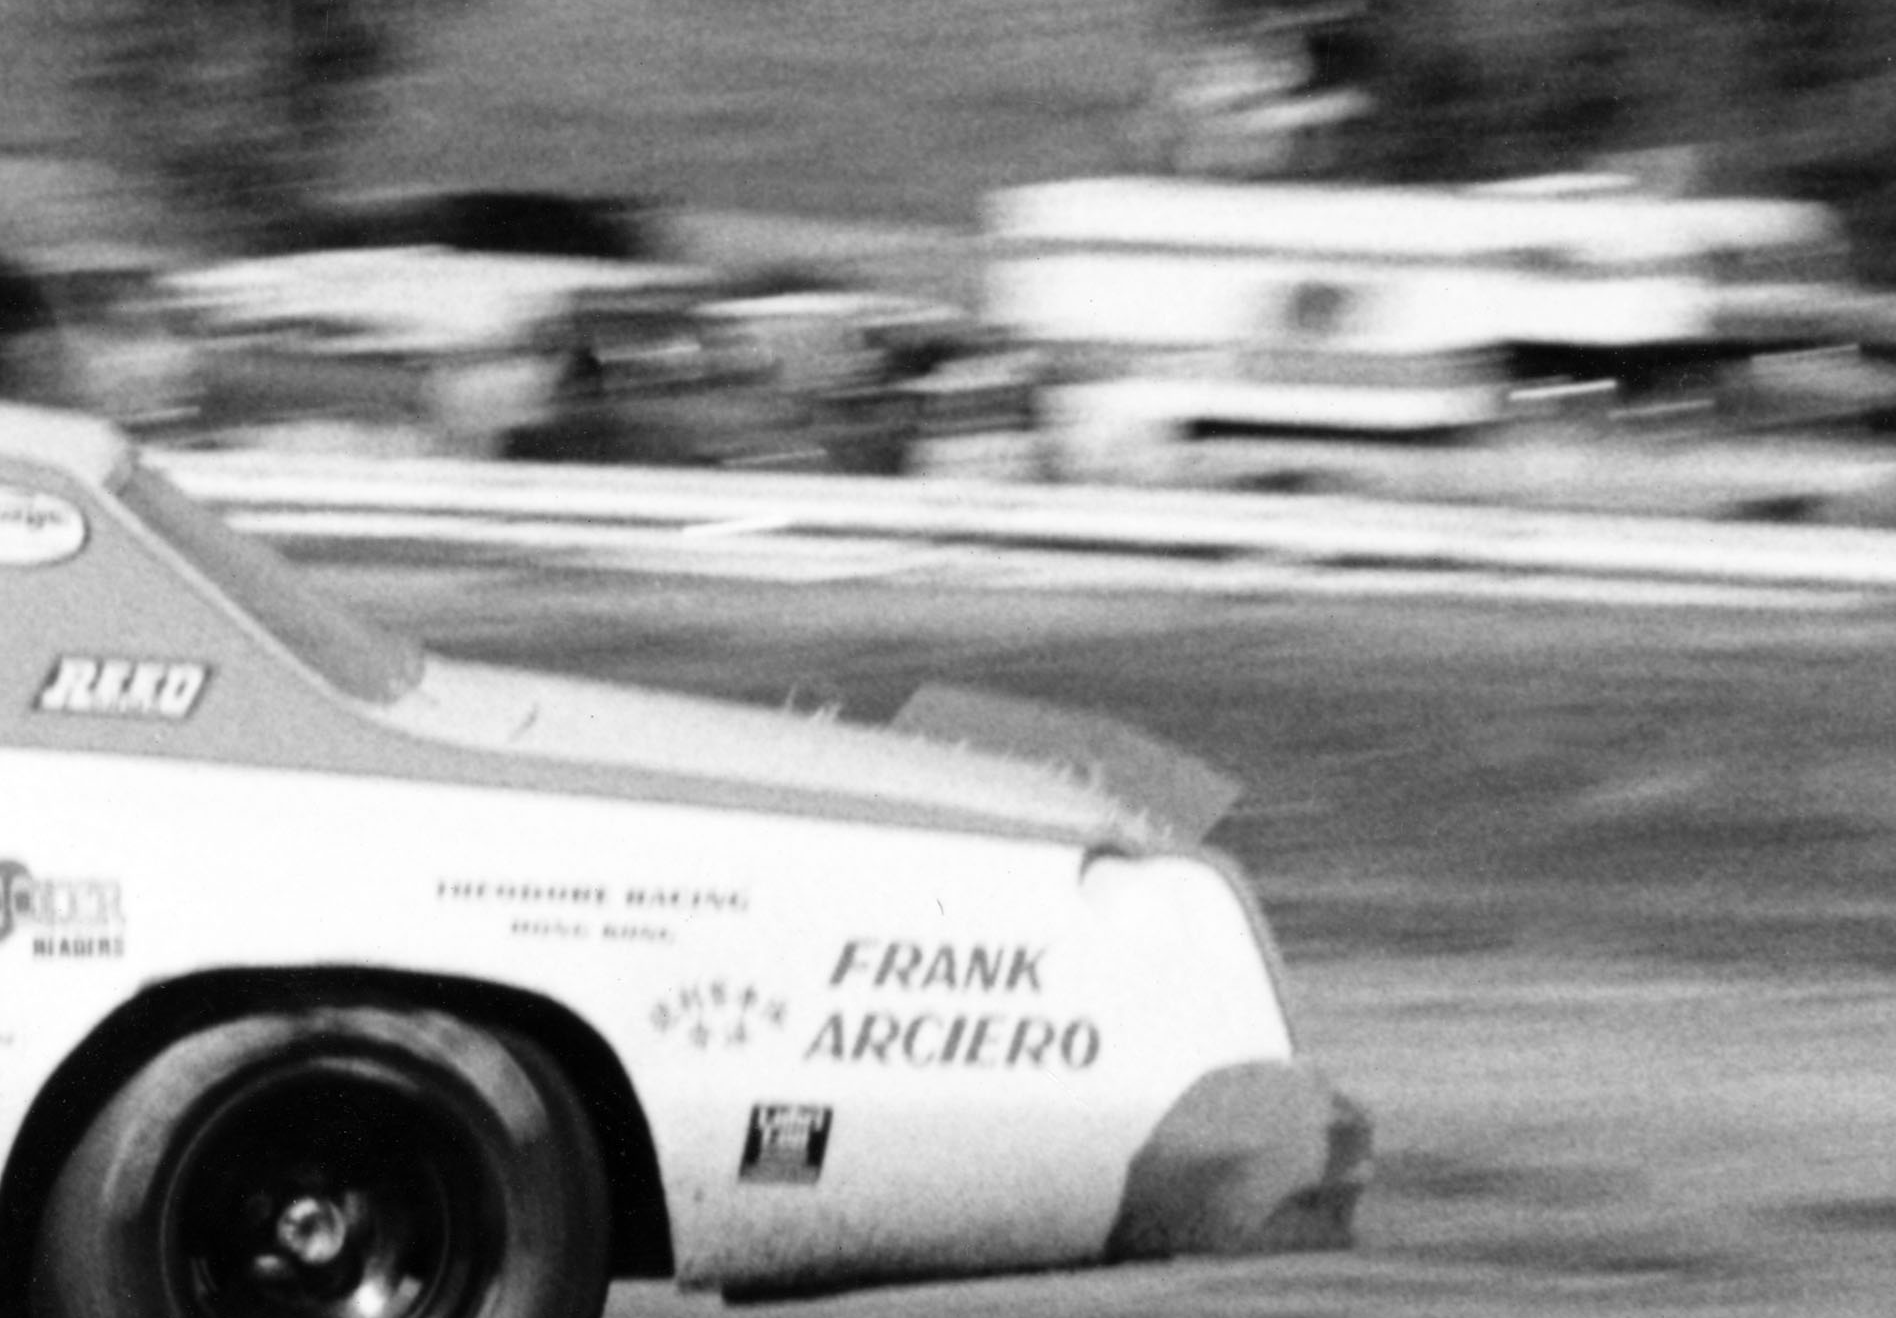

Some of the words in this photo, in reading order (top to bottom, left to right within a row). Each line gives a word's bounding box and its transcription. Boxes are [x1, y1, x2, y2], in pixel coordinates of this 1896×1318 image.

[40, 656, 206, 719] REED
[624, 888, 750, 911] RACING
[33, 938, 124, 958] HEADERS
[602, 923, 675, 944] KONG
[828, 938, 1050, 995] FRANK
[803, 1012, 1104, 1070] ARCIERO
